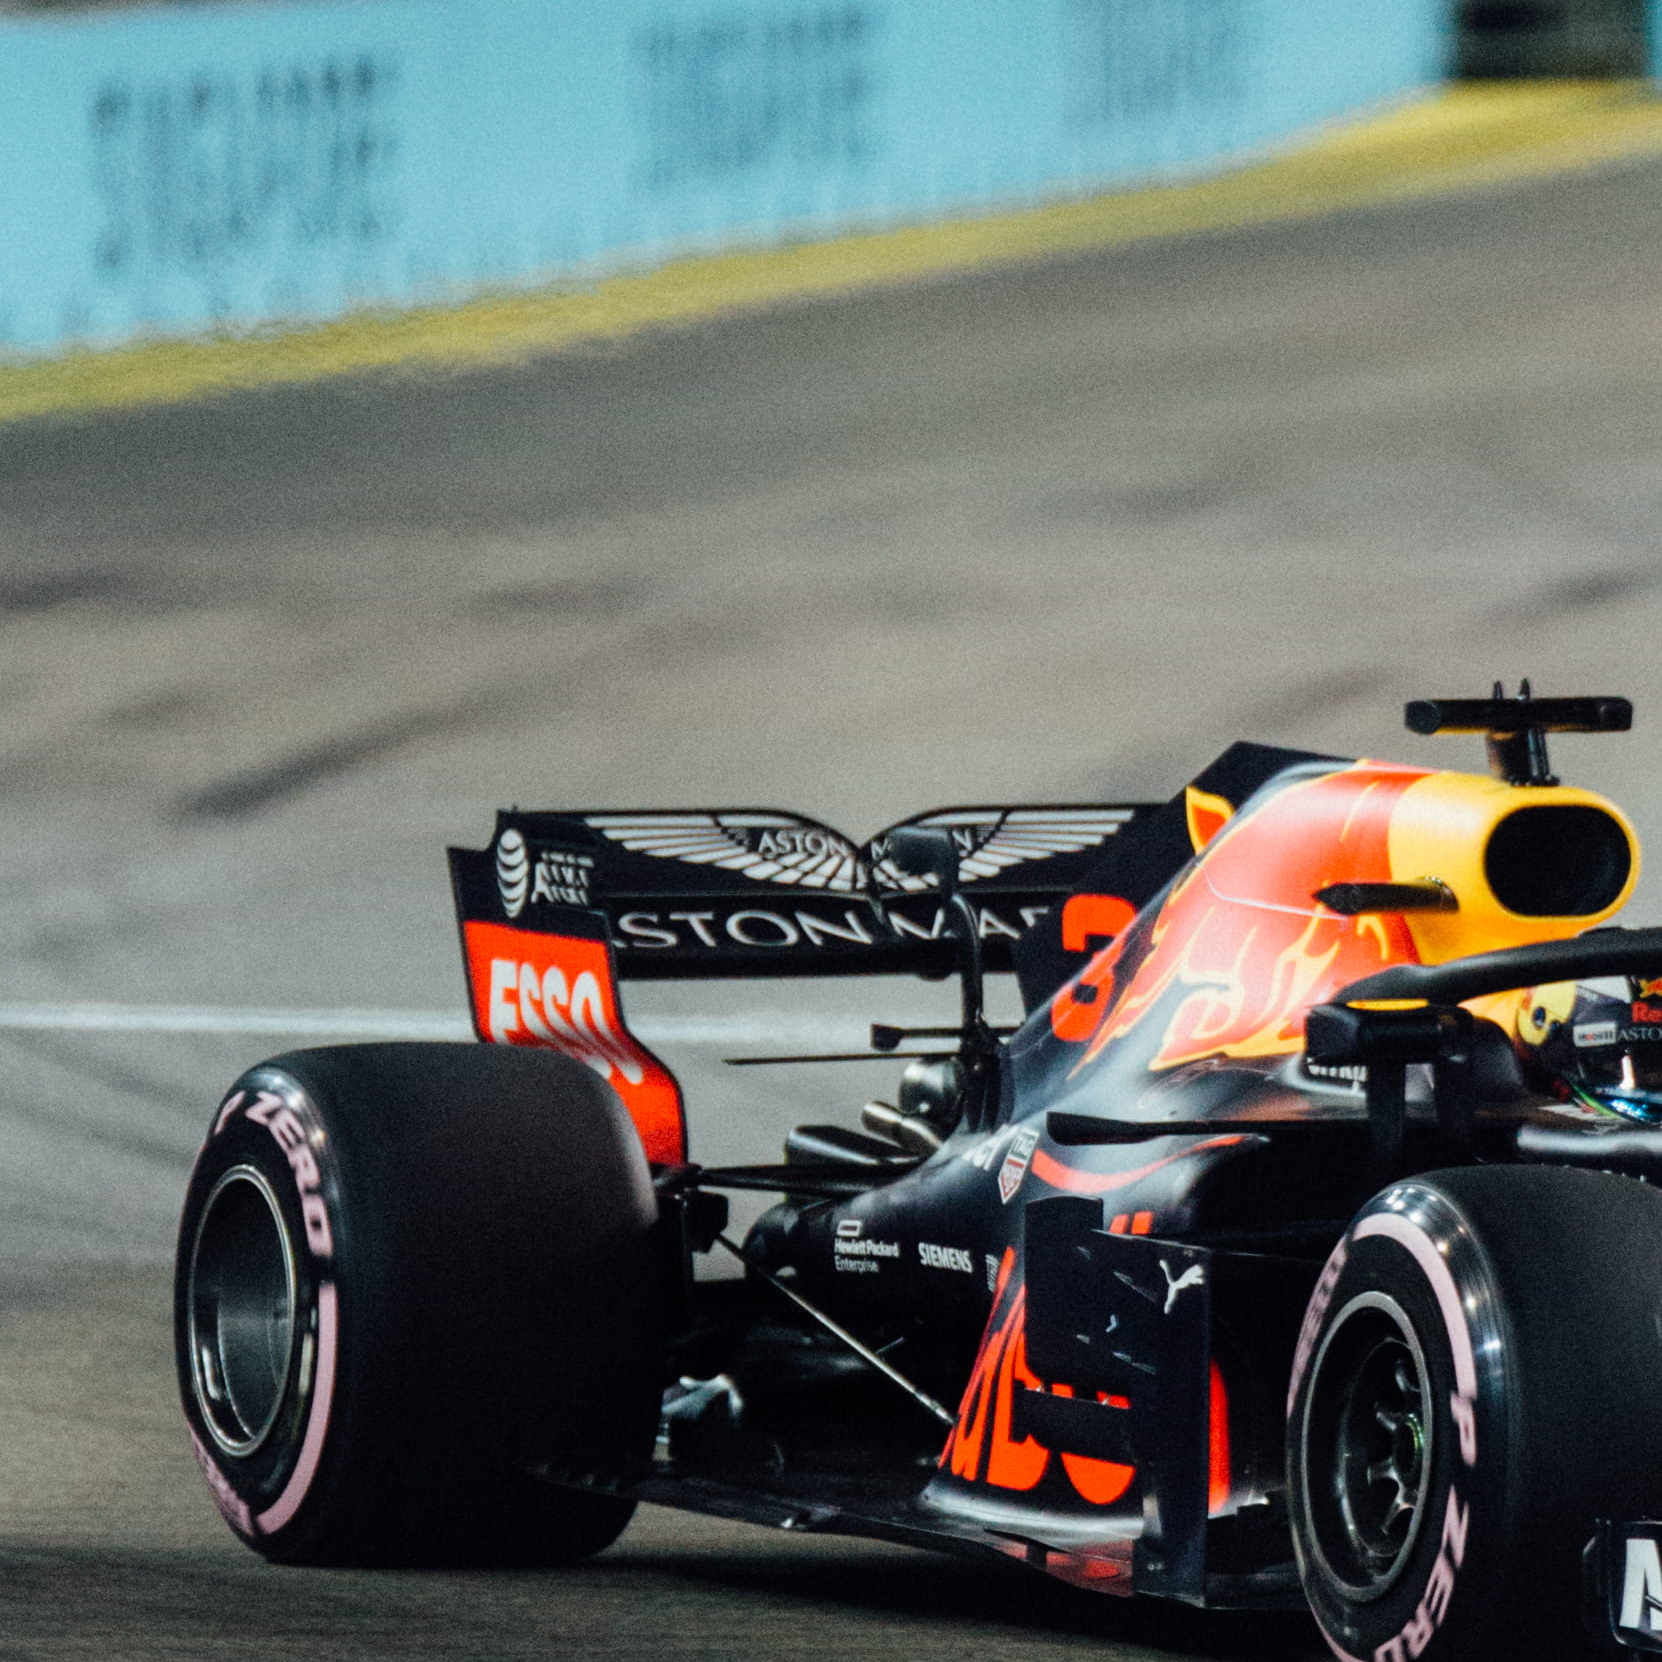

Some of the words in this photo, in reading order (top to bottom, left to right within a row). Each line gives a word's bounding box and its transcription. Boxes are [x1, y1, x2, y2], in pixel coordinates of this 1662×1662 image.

[757, 829, 849, 859] ASTON
[611, 910, 873, 948] STON
[245, 1091, 333, 1259] ZERO
[834, 1237, 866, 1256] Hewlett
[867, 1239, 900, 1258] Packard
[918, 1242, 973, 1273] SIEMENS
[834, 1255, 879, 1274] Enterprise
